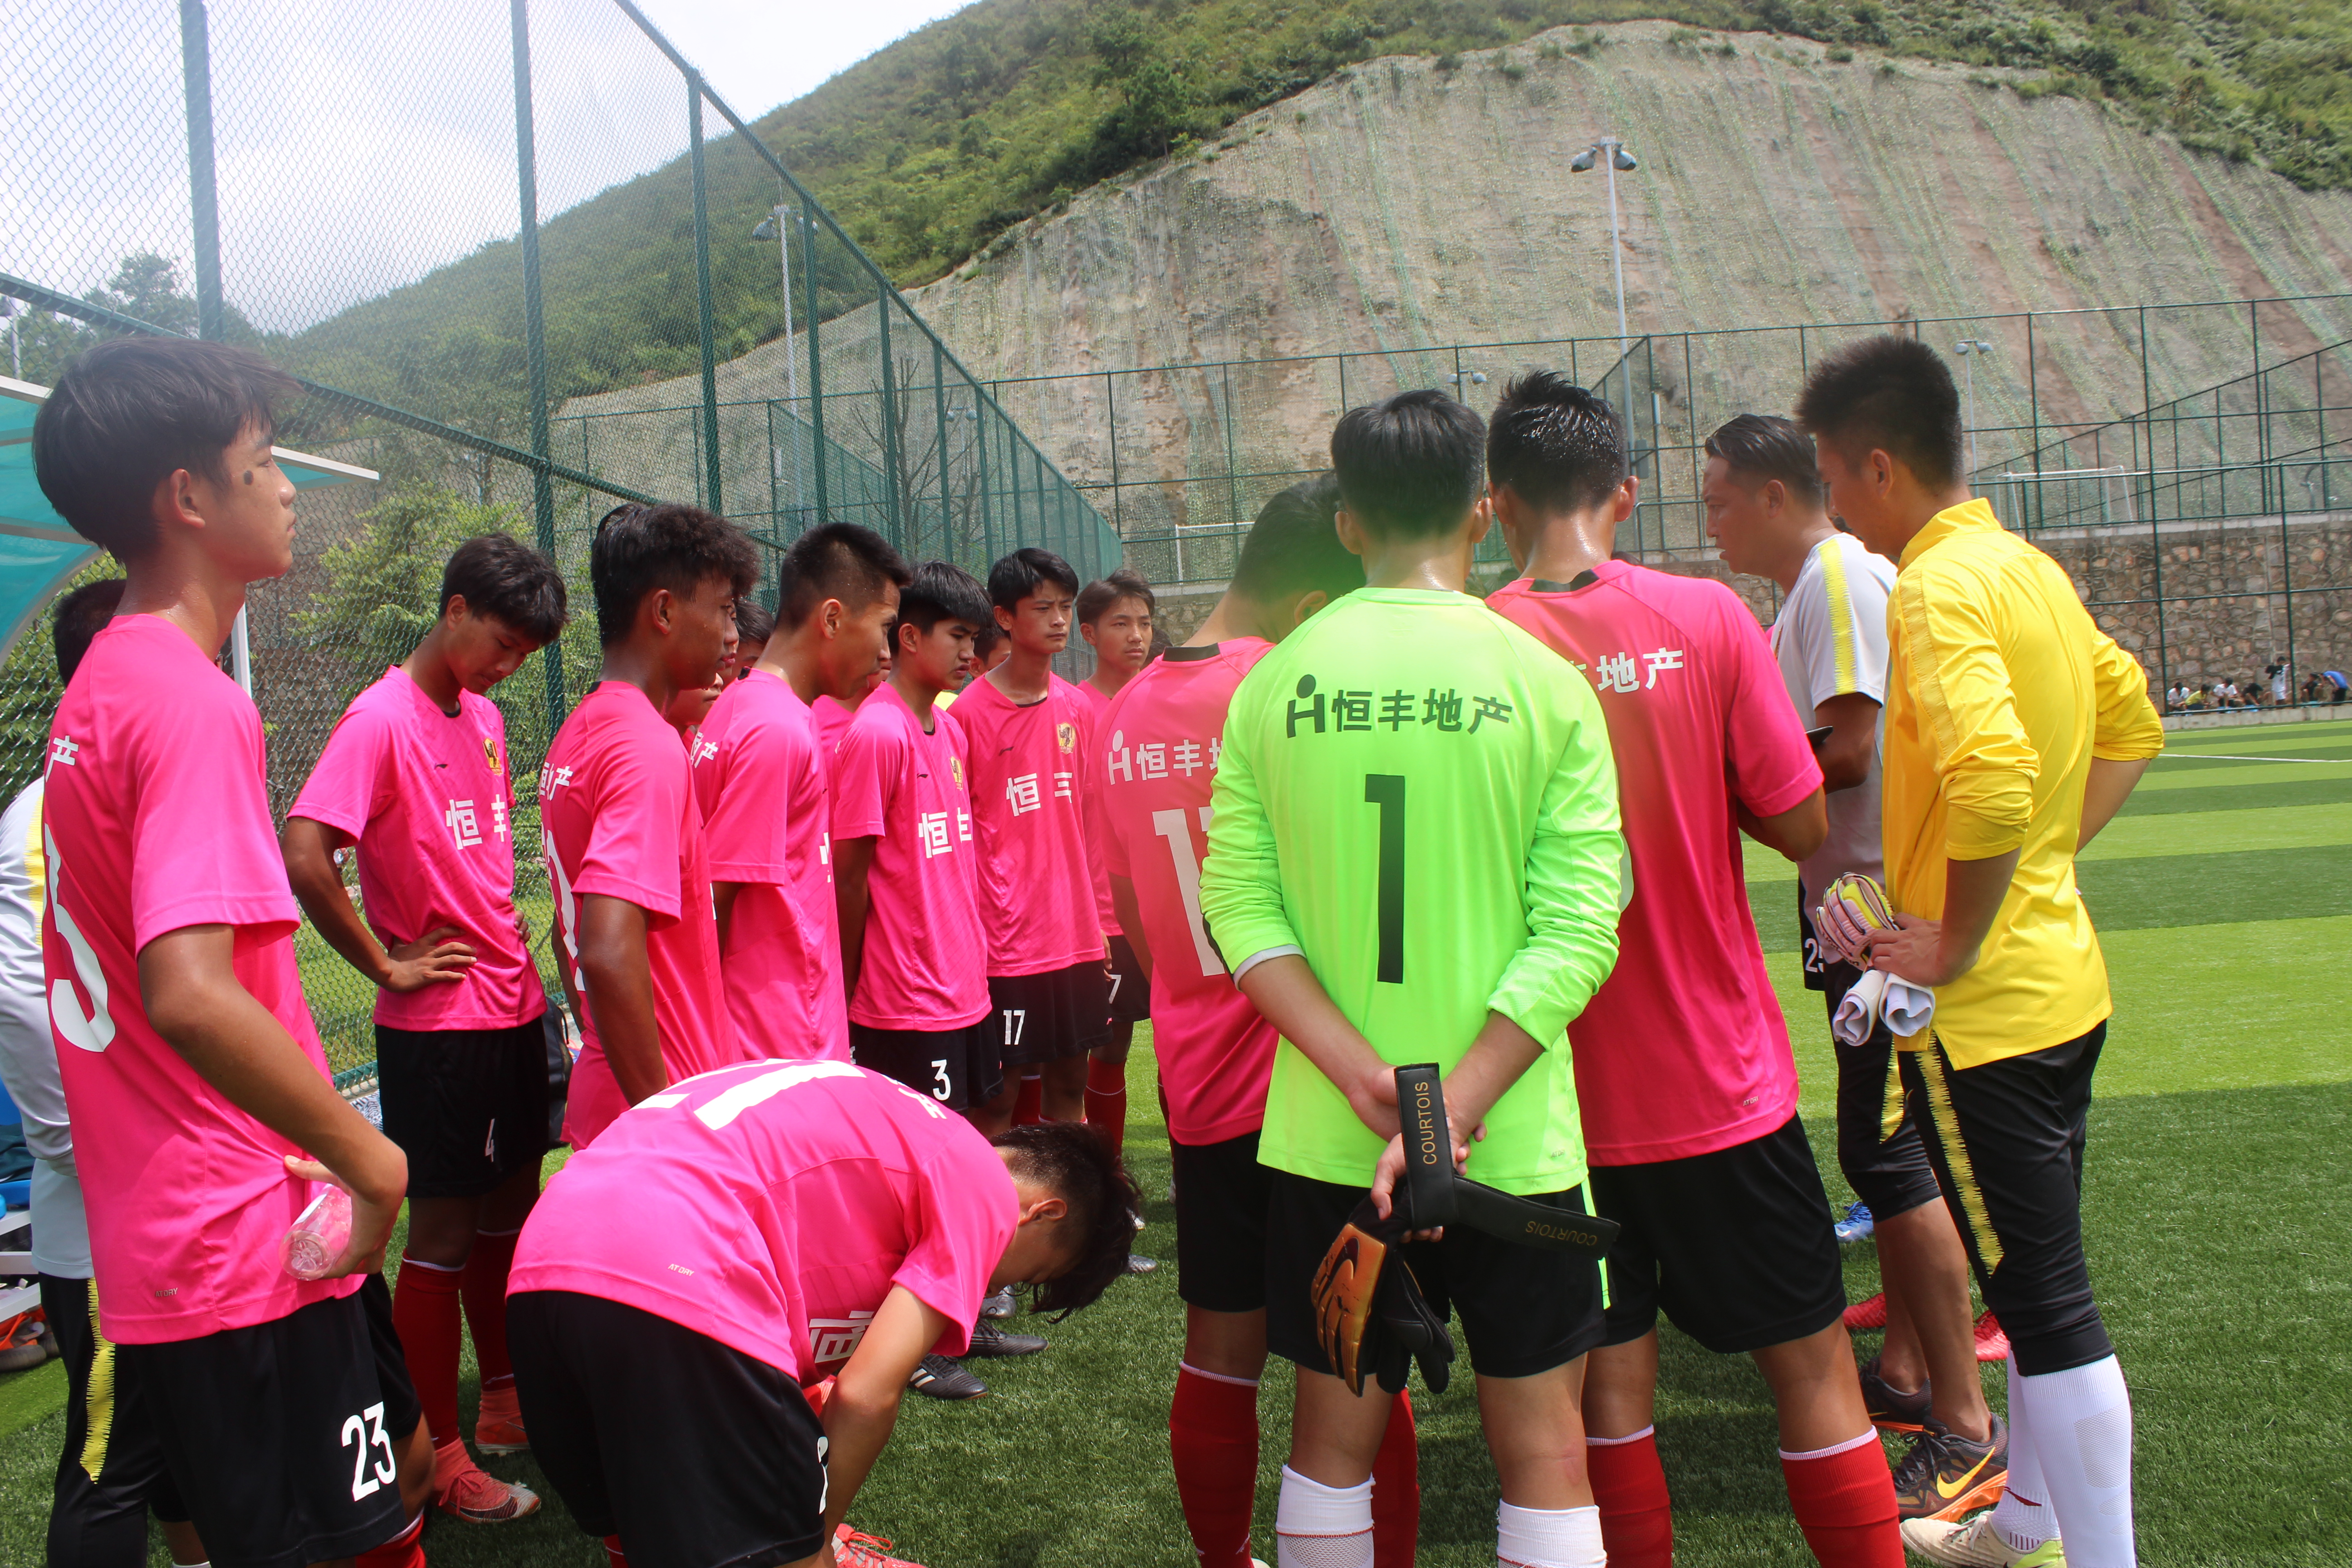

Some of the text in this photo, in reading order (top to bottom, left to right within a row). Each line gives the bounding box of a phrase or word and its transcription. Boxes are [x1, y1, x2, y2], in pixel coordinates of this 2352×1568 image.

[1569, 647, 1683, 693] 地产
[1365, 774, 1405, 984] 1
[1003, 1010, 1025, 1045] 17
[931, 1059, 951, 1101] 3
[485, 1118, 495, 1162] 4
[1415, 1082, 1437, 1165] COURTOIS
[1525, 1221, 1597, 1246] COURTOIS
[342, 1401, 396, 1501] 23
